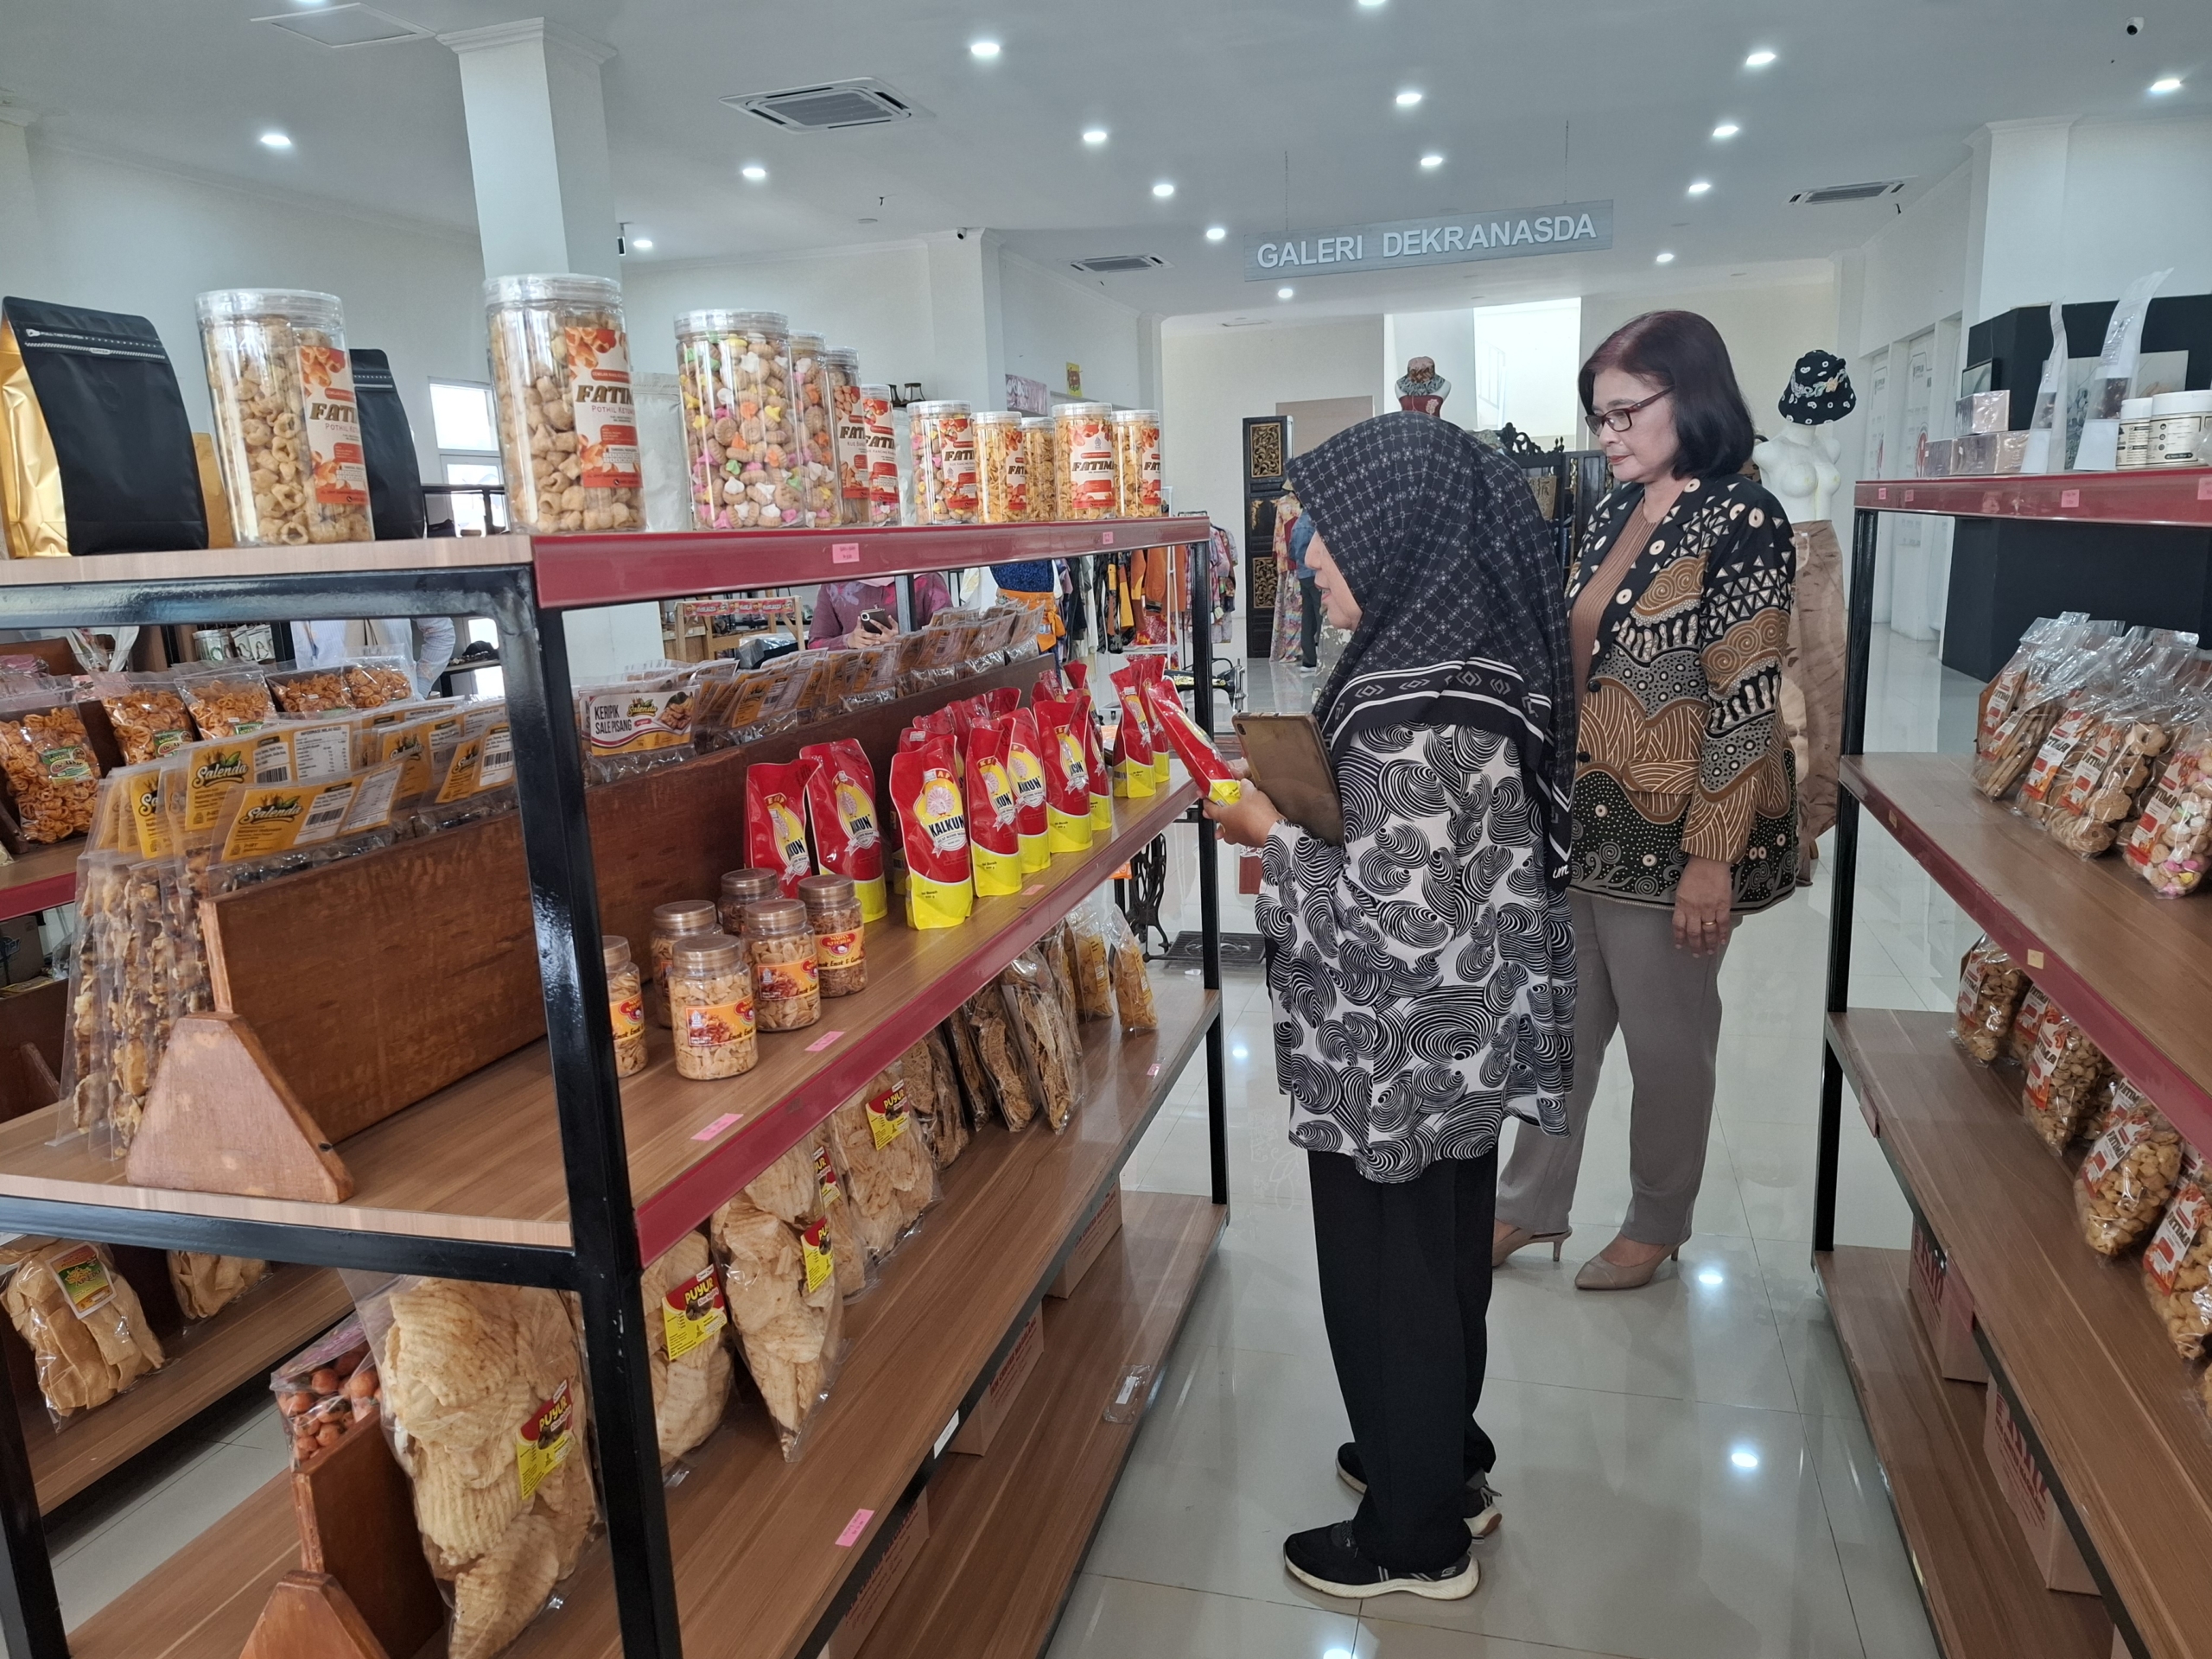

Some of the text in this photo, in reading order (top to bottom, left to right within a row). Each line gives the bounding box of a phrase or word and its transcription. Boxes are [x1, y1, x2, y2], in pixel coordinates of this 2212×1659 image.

[1256, 213, 1598, 269] GALERI DEKRANASDA
[594, 705, 620, 720] KERIPIK
[626, 704, 658, 717] Salenda
[595, 719, 632, 735] SALE PISANG
[192, 760, 249, 789] Salenda
[238, 803, 302, 825] Salenda
[929, 815, 964, 838] KALKUN
[883, 1089, 905, 1109] PUYUR
[684, 1277, 714, 1306] PUYUR
[539, 1395, 568, 1433] PUYUR
